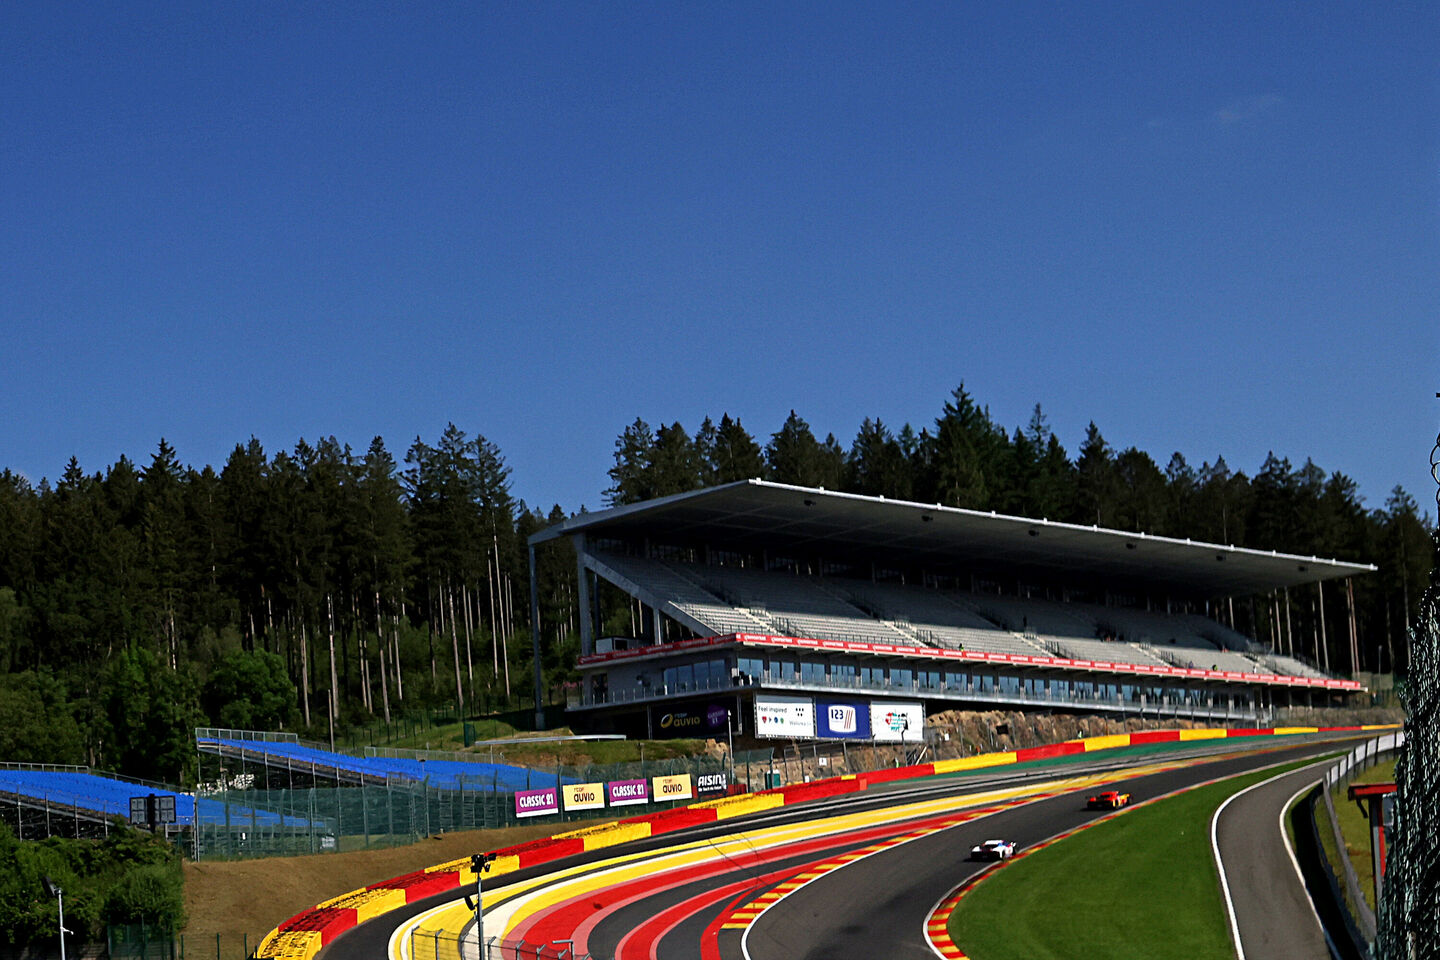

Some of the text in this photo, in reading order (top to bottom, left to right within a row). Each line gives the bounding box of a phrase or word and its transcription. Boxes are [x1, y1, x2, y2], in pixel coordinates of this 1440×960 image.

[830, 709, 844, 720] 123
[698, 774, 722, 787] AISIN
[612, 785, 636, 798] CLASSIC
[662, 783, 682, 794] auvio
[519, 794, 546, 808] CLASSIC
[574, 792, 595, 803] auvio
